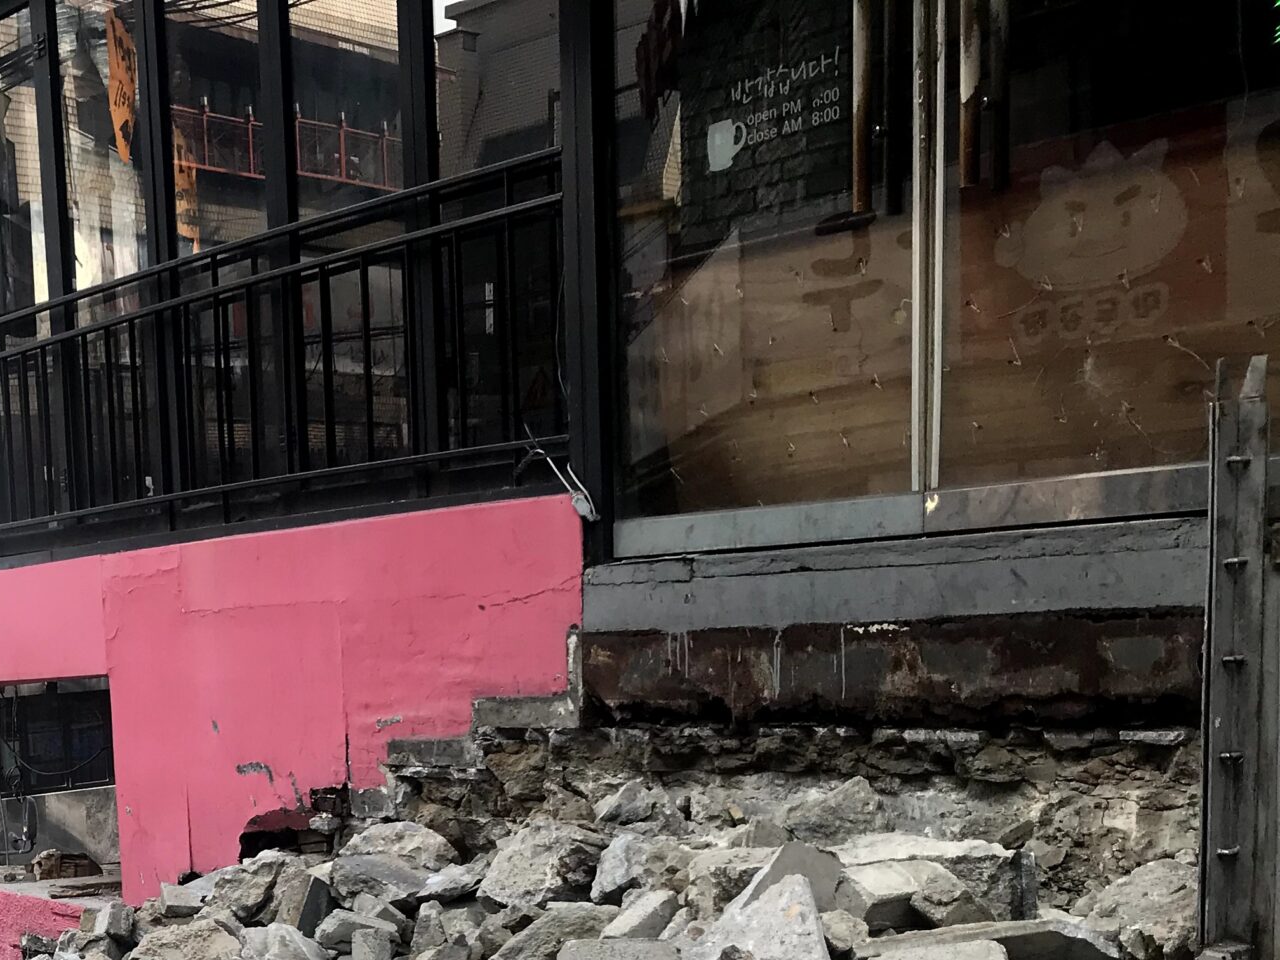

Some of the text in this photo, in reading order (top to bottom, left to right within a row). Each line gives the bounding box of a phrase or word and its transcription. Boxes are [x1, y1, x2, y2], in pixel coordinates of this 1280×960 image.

[731, 46, 839, 104] 반갑습니다!
[747, 108, 777, 127] open
[782, 99, 801, 117] PM
[747, 106, 840, 144] close AM 8:00
